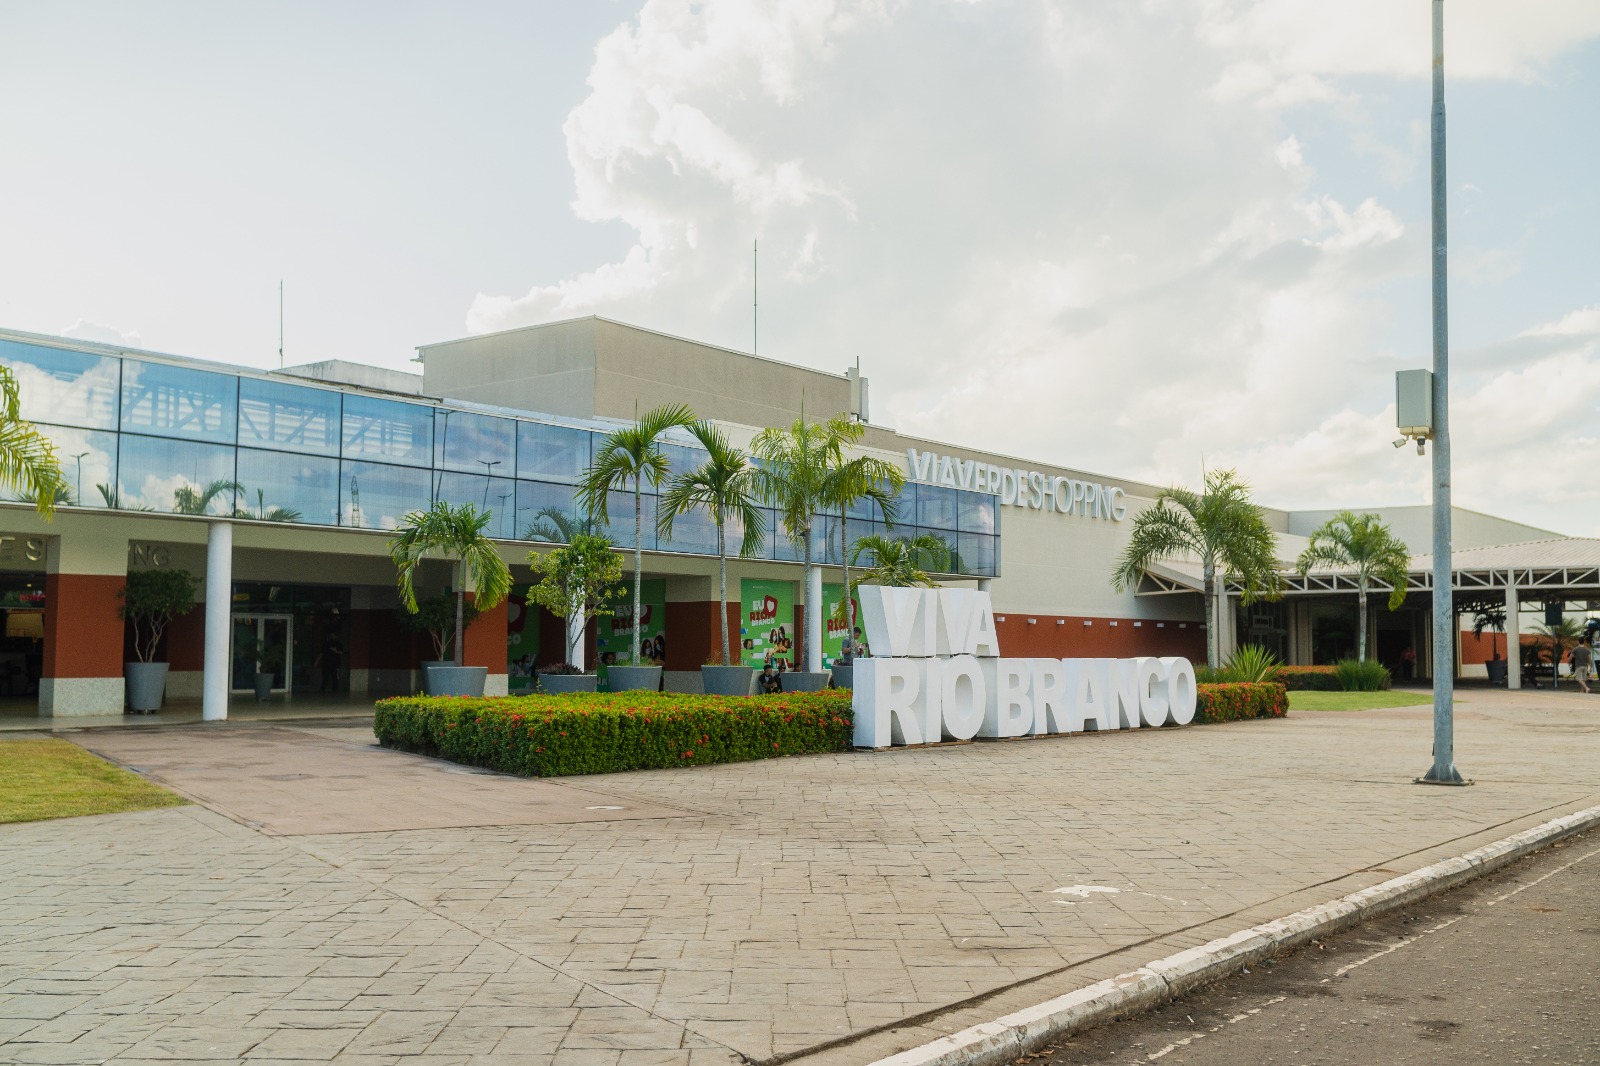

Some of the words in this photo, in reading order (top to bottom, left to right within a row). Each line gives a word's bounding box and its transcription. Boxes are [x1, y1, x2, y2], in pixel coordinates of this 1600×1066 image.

[752, 599, 764, 611] EU
[858, 585, 1000, 657] VIVA
[853, 654, 986, 748] RIO
[985, 656, 1198, 739] BRANCO
